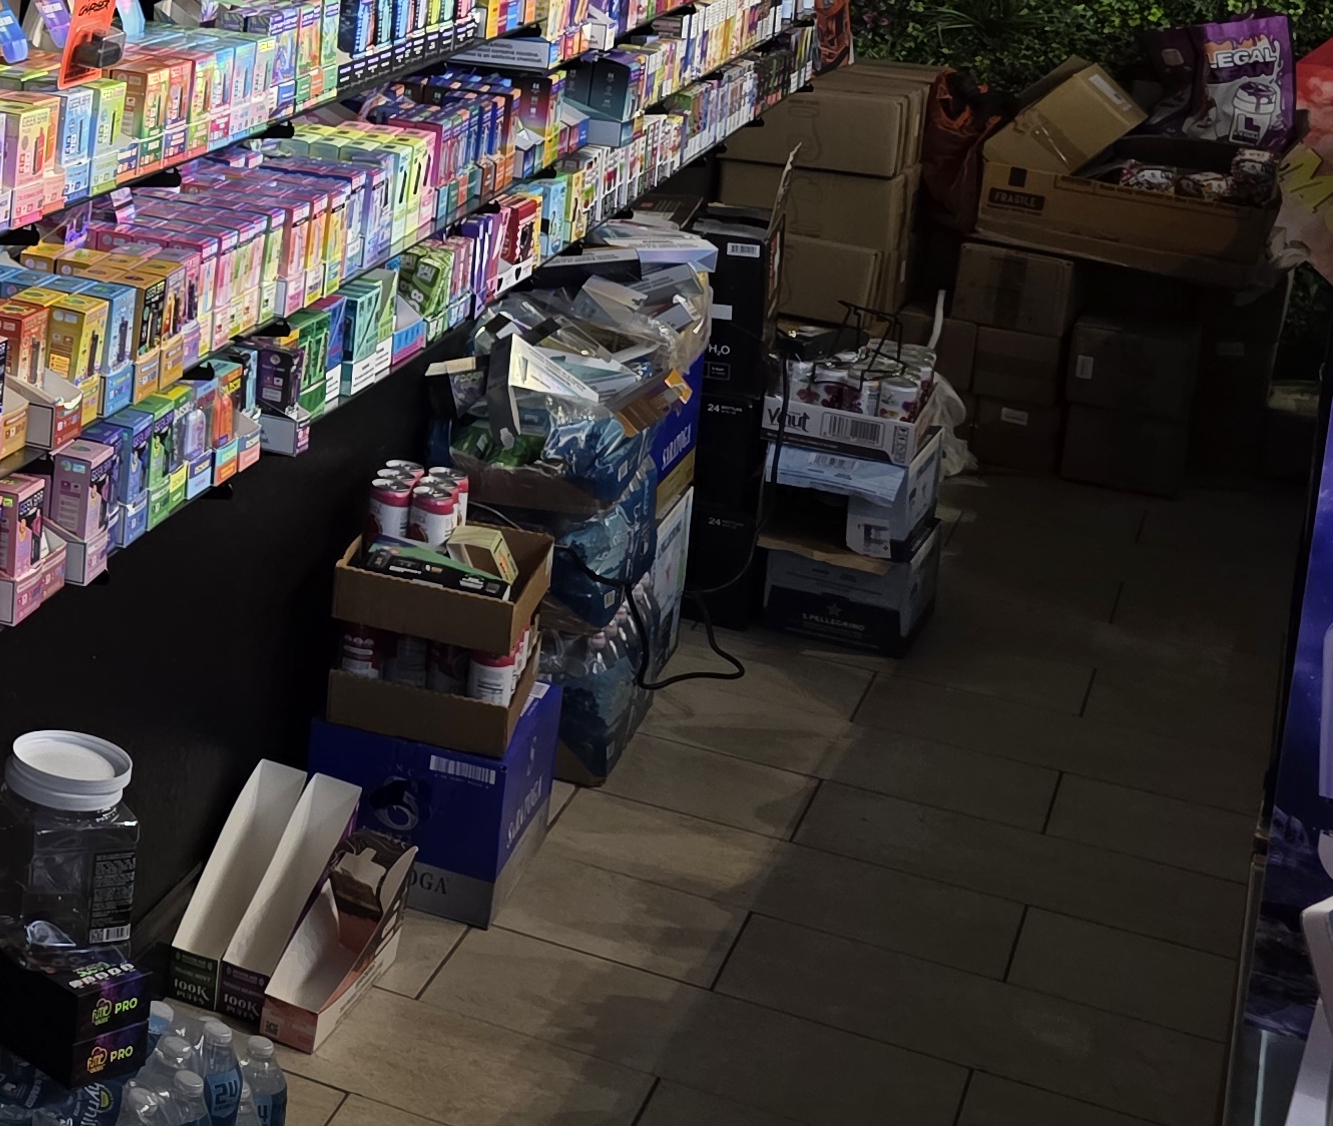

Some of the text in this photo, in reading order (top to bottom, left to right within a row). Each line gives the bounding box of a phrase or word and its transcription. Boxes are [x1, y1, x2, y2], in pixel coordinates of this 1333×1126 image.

[994, 192, 1036, 206] FRAGILE
[707, 403, 720, 413] 24
[767, 406, 811, 432] Vnut
[115, 998, 138, 1014] PRO
[110, 1046, 133, 1063] PRO
